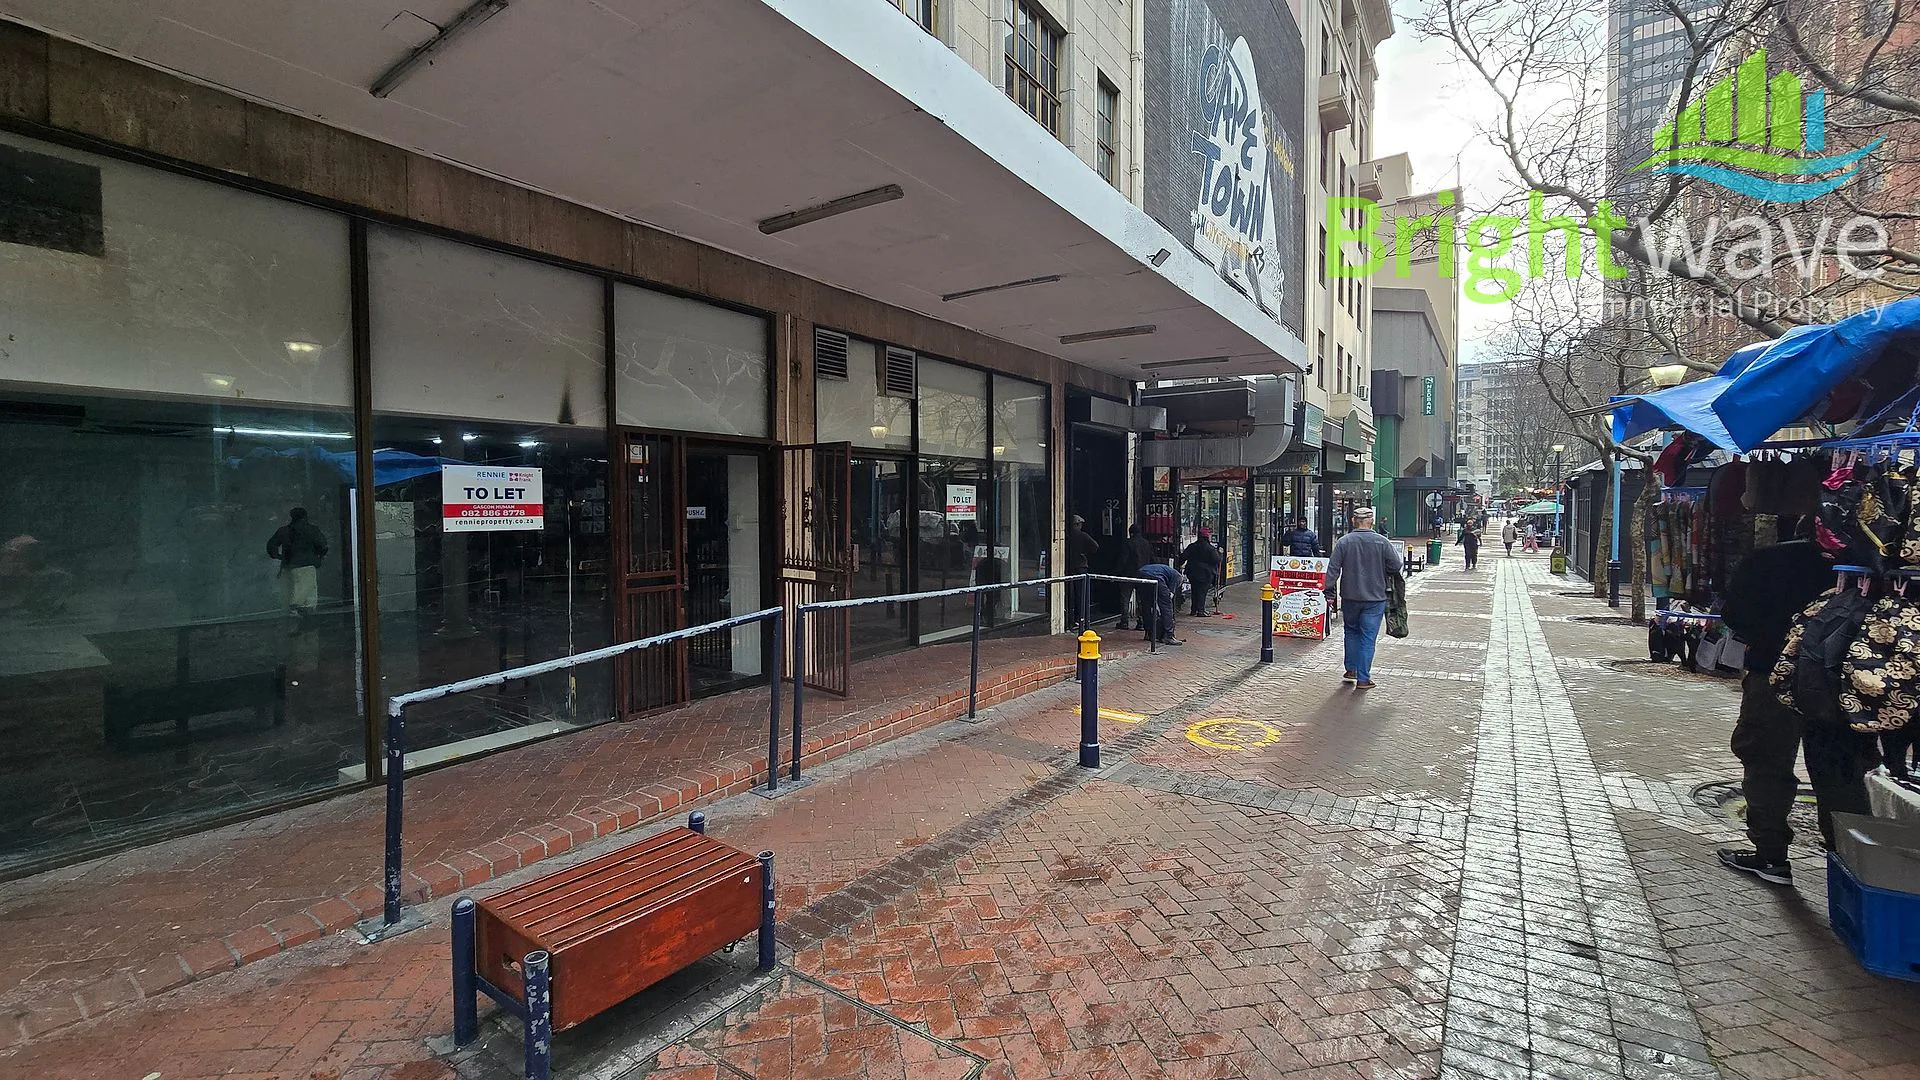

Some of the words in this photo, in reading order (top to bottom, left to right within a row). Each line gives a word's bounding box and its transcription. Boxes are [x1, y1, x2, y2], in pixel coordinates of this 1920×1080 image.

[1199, 44, 1258, 172] CAPE
[1191, 130, 1267, 242] TOWN
[463, 487, 488, 500] TO
[494, 487, 525, 500] LET
[1106, 499, 1119, 509] 32
[455, 518, 534, 526] rennieproperty.co.za
